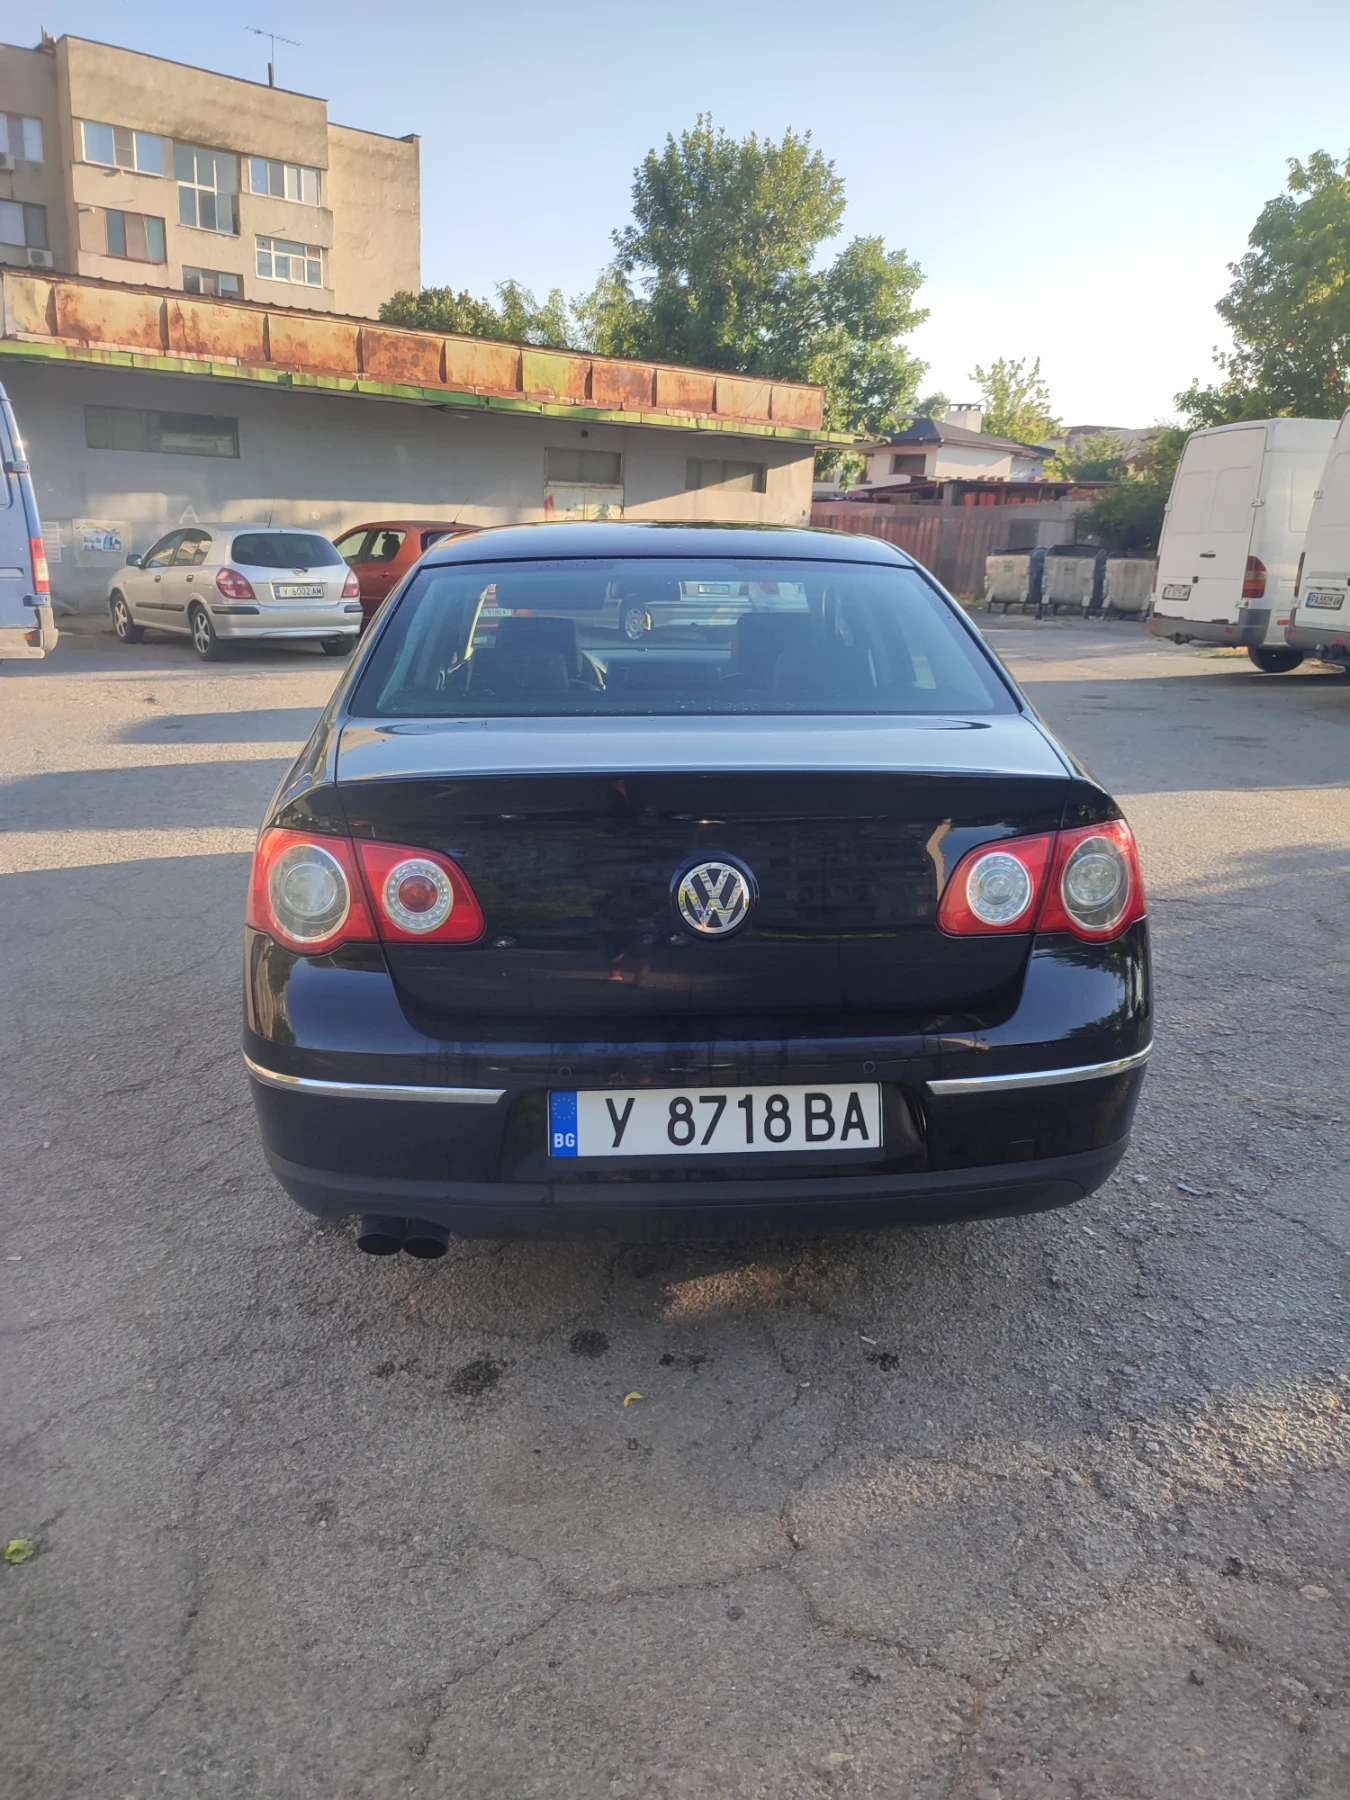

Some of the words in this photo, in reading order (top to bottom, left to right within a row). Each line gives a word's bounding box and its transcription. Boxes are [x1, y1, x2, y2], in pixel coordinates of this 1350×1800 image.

[292, 587, 311, 596] 6002
[678, 862, 749, 933] VW
[605, 1097, 636, 1149] Y
[553, 1132, 576, 1149] BG
